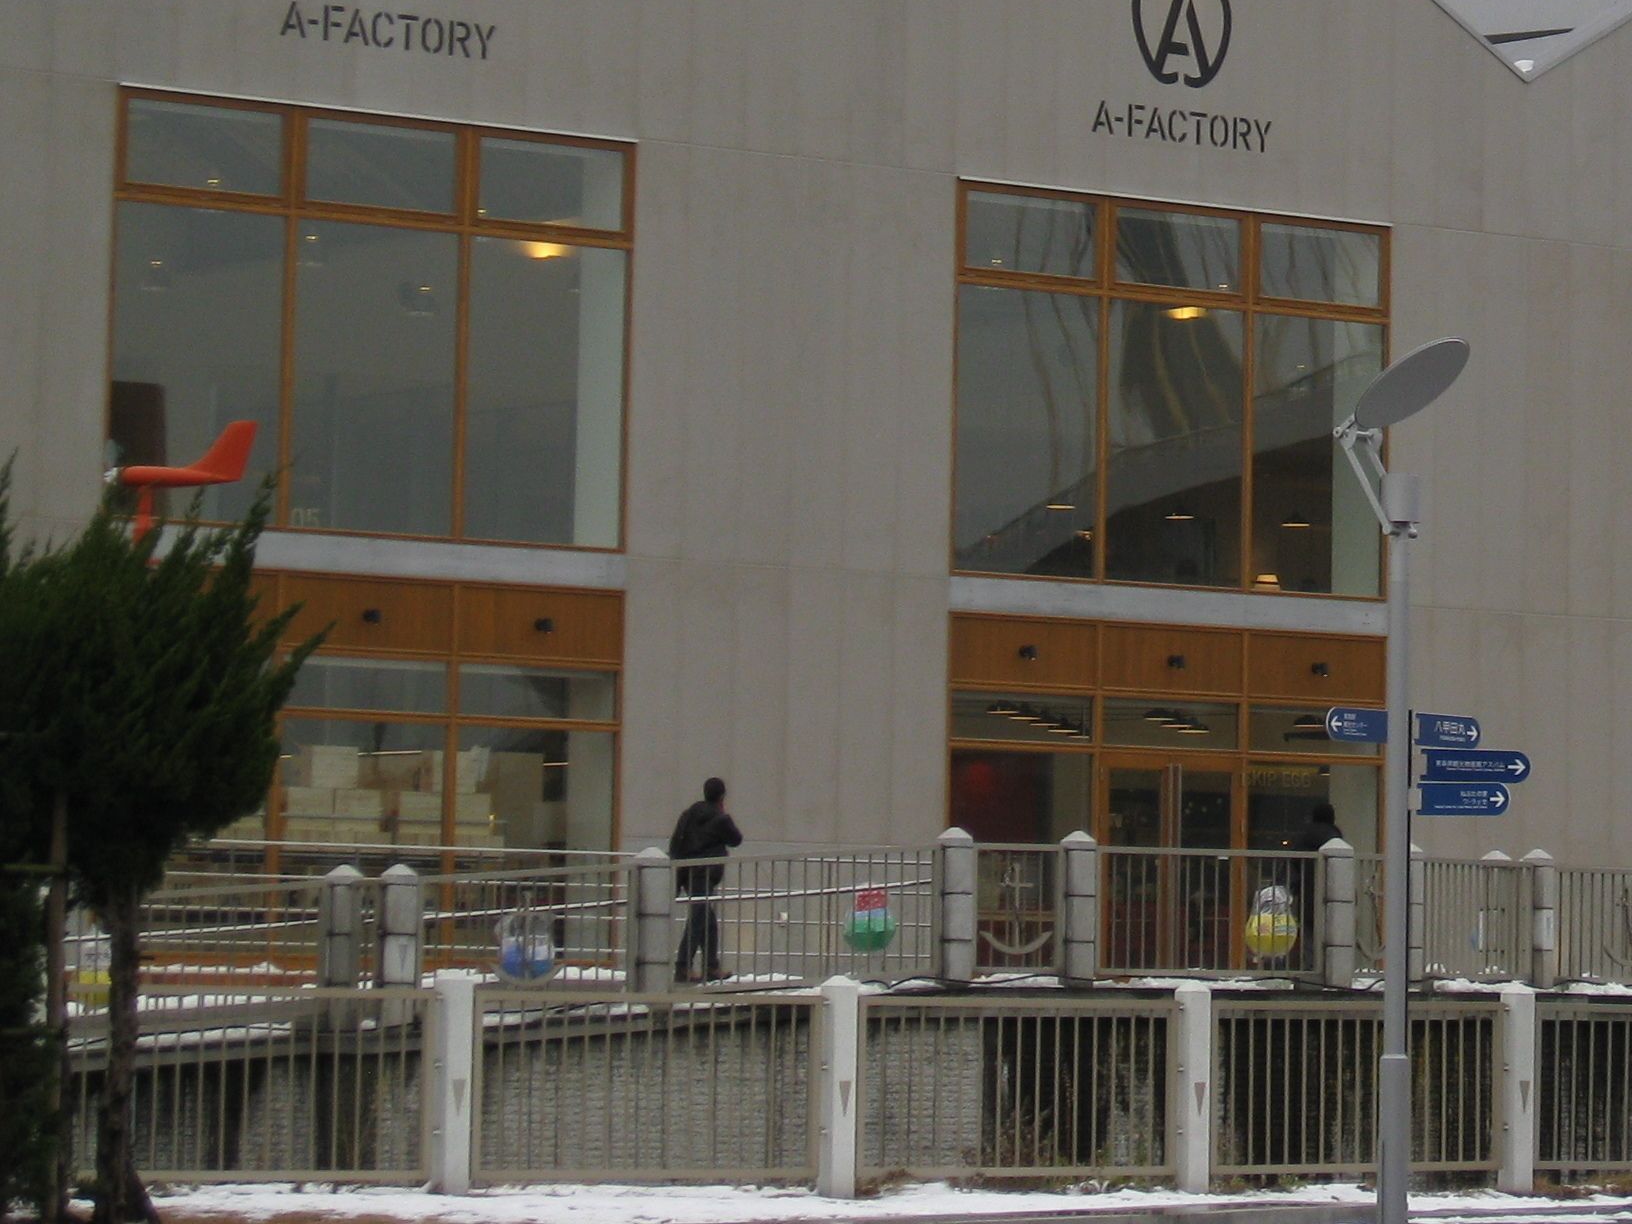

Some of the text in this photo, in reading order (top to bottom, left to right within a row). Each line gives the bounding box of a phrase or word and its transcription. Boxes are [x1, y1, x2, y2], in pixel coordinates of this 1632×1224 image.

[280, 1, 495, 59] A-FACTORY
[1092, 101, 1271, 152] A-FACTORY
[1434, 720, 1466, 734] 八甲田丸
